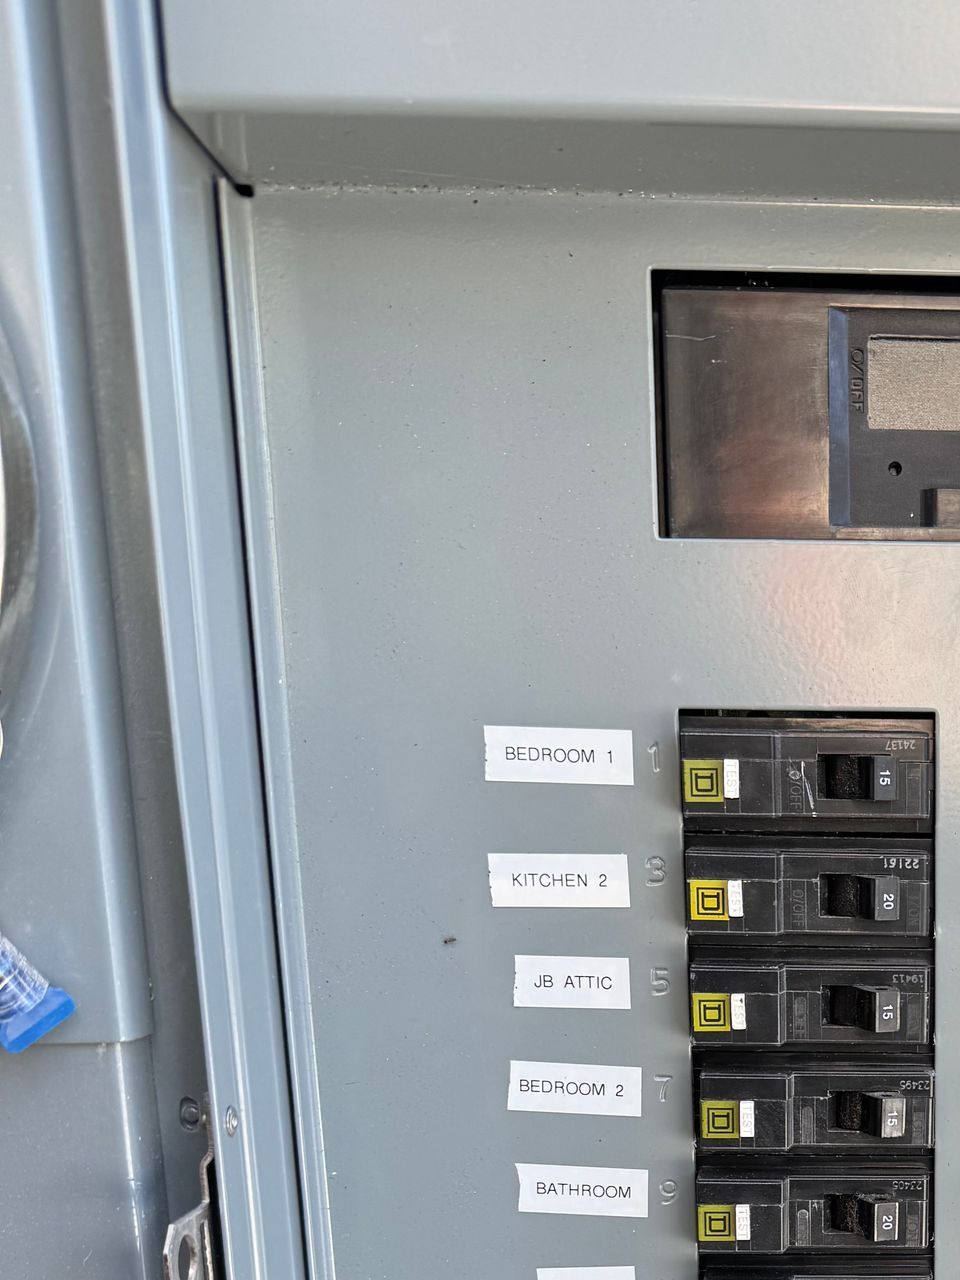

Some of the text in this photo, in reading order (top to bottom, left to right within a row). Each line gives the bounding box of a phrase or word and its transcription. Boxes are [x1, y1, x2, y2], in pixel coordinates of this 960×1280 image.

[885, 740, 916, 750] 24137
[505, 746, 613, 763] BEDROOM 1
[648, 741, 660, 773] 1
[726, 761, 737, 795] TEST
[879, 770, 891, 785] 15
[644, 856, 666, 887] 3
[512, 874, 607, 887] KITCHEN 2
[729, 883, 741, 914] TEST
[883, 894, 894, 910] 20
[534, 975, 613, 989] JB ATTIC
[651, 967, 670, 997] 5
[892, 974, 924, 984] 19413
[882, 1004, 893, 1019] 15
[519, 1079, 624, 1097] BEDROOM 2
[653, 1074, 673, 1103] 7
[900, 1080, 930, 1090] 23495
[742, 1103, 753, 1134] TEST
[887, 1111, 897, 1126] 15
[536, 1182, 631, 1199] BATHROOM
[659, 1179, 679, 1205] 9
[892, 1180, 922, 1190] 23405
[738, 1205, 749, 1238] TEST
[882, 1215, 893, 1230] 20
